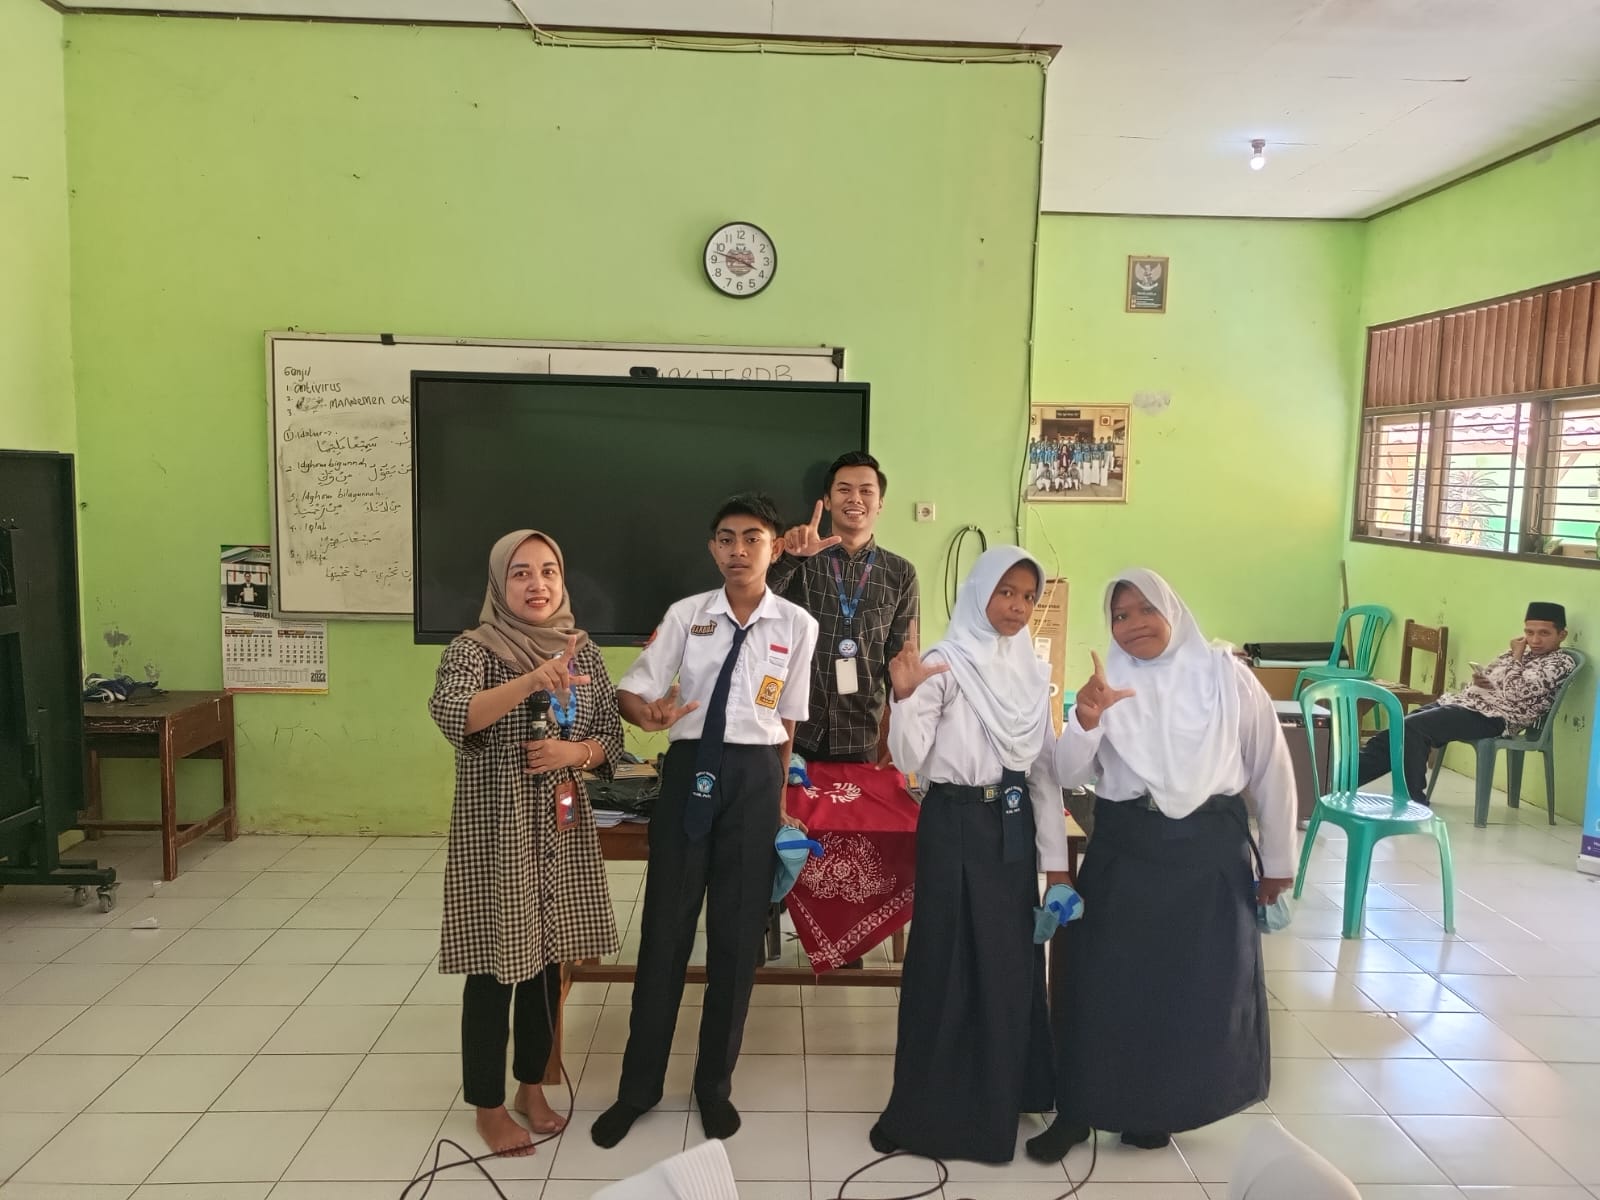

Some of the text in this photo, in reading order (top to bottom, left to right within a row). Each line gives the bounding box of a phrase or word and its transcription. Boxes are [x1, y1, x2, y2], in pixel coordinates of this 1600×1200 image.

[725, 233, 733, 243] 11
[736, 230, 746, 240] 12
[752, 233, 756, 243] 1
[716, 243, 726, 252] 10
[759, 243, 766, 253] 2
[710, 254, 718, 264] 9
[763, 257, 770, 266] 3
[714, 267, 722, 278] 8
[758, 270, 765, 279] 4
[725, 277, 732, 287] 7
[736, 281, 743, 291] 6
[748, 278, 756, 288] 5
